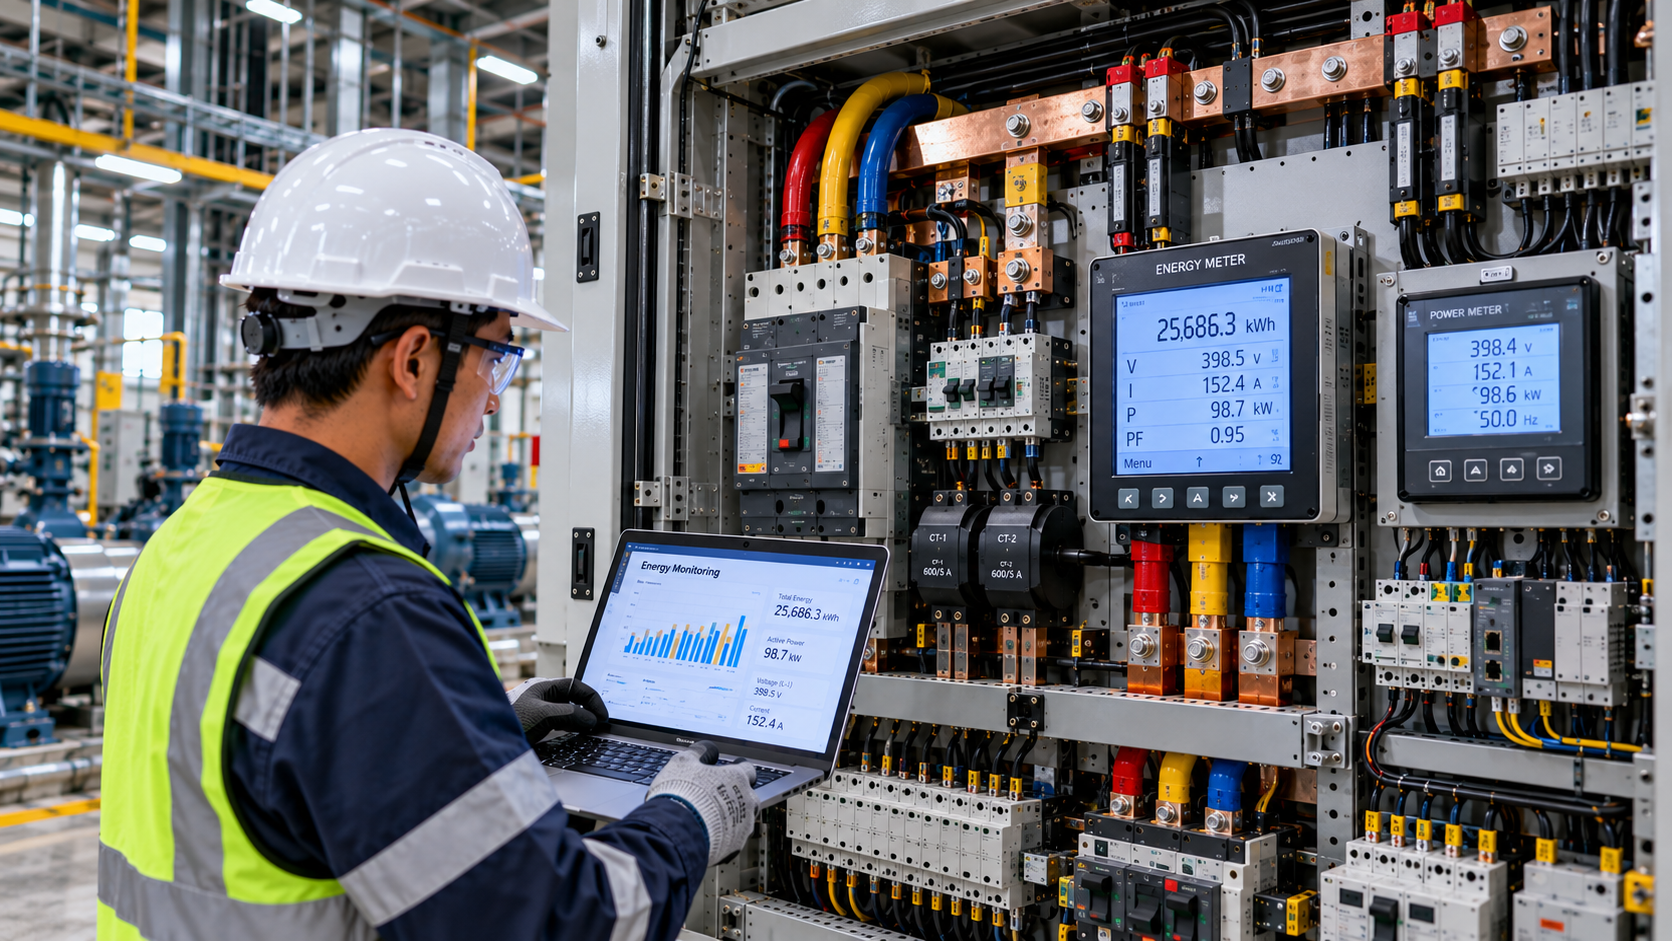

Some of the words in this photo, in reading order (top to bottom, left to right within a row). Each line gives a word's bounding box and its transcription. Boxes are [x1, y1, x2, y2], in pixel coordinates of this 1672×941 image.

[1156, 259, 1202, 275] ENERGY
[1205, 253, 1246, 269] METER
[1430, 308, 1465, 320] POWER
[1468, 305, 1502, 317] METER
[1157, 311, 1236, 342] 25,686.3
[1246, 317, 1275, 334] kWh
[1470, 337, 1517, 358] 398.4
[1127, 359, 1137, 374] V
[1201, 350, 1245, 369] 398.5
[1473, 361, 1515, 380] 152.1
[1524, 366, 1533, 377] A
[1202, 374, 1245, 394] 152.4
[1253, 377, 1262, 390] A
[1524, 389, 1542, 401] kW
[1127, 407, 1136, 423] P
[1211, 400, 1245, 419] 98.7
[1253, 401, 1273, 416] kW
[1480, 409, 1517, 428] 50.0
[1524, 414, 1539, 426] Hz
[1126, 431, 1144, 447] PF
[1210, 425, 1245, 444] 0.95
[1124, 458, 1152, 469] Menu
[929, 533, 947, 543] CT-1
[997, 534, 1017, 543] CT-2
[641, 560, 670, 574] Energy
[672, 564, 721, 579] Monitoring
[946, 568, 952, 577] A
[1016, 570, 1023, 579] A
[778, 593, 792, 601] Total
[792, 594, 814, 604] Energy
[774, 604, 822, 620] 25,686.3
[822, 613, 840, 622] kWh
[786, 638, 805, 646] Power
[764, 647, 788, 661] 98.7
[788, 653, 802, 662] kW
[747, 715, 776, 729] 152.4
[776, 722, 784, 730] A
